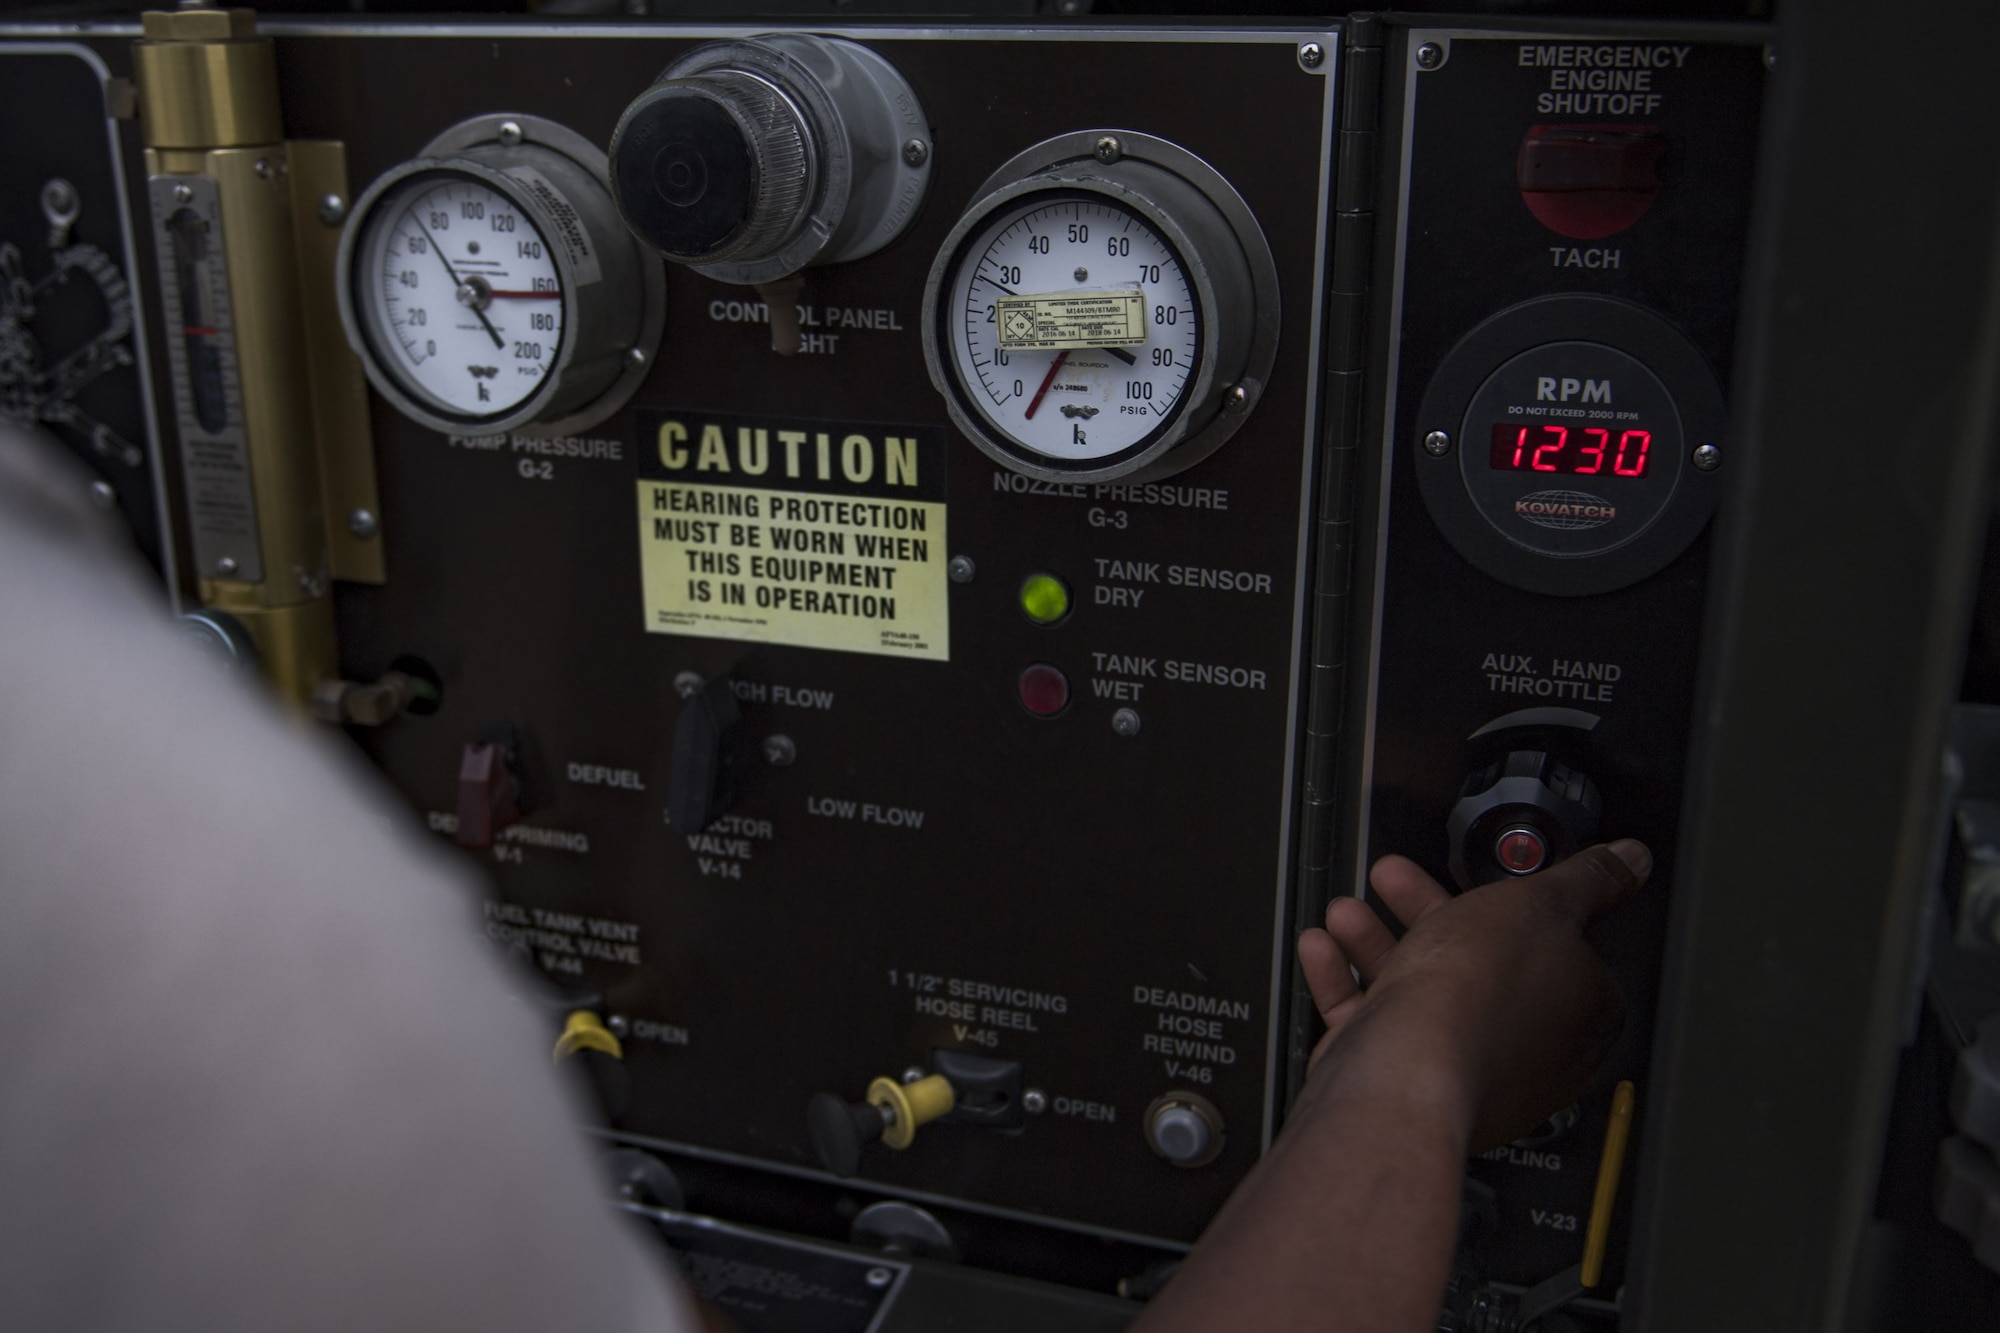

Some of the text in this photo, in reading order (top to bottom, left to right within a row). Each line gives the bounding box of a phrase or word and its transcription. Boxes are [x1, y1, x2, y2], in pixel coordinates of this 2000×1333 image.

[1518, 45, 1692, 68] EMERGENCY
[1550, 69, 1653, 92] ENGINE
[1536, 92, 1662, 115] SHUTOFF
[430, 212, 449, 230] 80
[461, 202, 485, 220] 100
[491, 214, 515, 233] 120
[1068, 225, 1088, 243] 50
[408, 237, 427, 254] 60
[518, 241, 541, 259] 140
[1028, 236, 1049, 255] 40
[1108, 237, 1129, 257] 60
[1549, 247, 1620, 269] TACH
[400, 272, 418, 288] 40
[1000, 266, 1020, 285] 30
[1139, 265, 1160, 284] 70
[408, 308, 427, 326] 20
[530, 313, 554, 331] 180
[826, 307, 904, 331] PANEL
[986, 306, 995, 323] 2
[1155, 306, 1176, 325] 80
[427, 340, 437, 357] 0
[514, 341, 541, 359] 200
[994, 348, 1008, 366] 10
[1152, 348, 1172, 367] 90
[1014, 380, 1023, 397] 0
[1126, 381, 1152, 400] 100
[1536, 376, 1612, 404] RPM
[1120, 406, 1147, 415] PSIG
[1508, 405, 1639, 421] DO NOT EXCEED 2000 RPM
[511, 433, 623, 460] PRESSURE
[657, 420, 919, 487] CAUTION
[1512, 425, 1652, 477] 1230
[518, 458, 554, 480] G-2
[992, 472, 1229, 510] NOZZLE PRESSURE
[653, 488, 926, 531] HEARING PROTECTION
[1088, 507, 1128, 529] G-3
[1514, 501, 1616, 519] KOVATCH
[654, 518, 928, 562] MUST BE WORN WHEN
[685, 550, 896, 590] THIS EQUIPMENT
[1094, 558, 1272, 594] TANK SENSOR
[688, 580, 711, 602] IS
[722, 583, 745, 605] IN
[756, 585, 896, 620] OPERATION
[1094, 585, 1145, 608] DRY
[1092, 652, 1267, 690] TANK SENSOR
[1481, 653, 1621, 682] AUX. HAND
[772, 685, 834, 710] FLOW
[1092, 678, 1144, 701] WET
[1486, 673, 1614, 703] THROTTLE
[567, 762, 646, 791] DEFUEL
[808, 796, 925, 829] LOW FLOW
[494, 844, 523, 864] V-1
[687, 835, 752, 859] VALVE
[698, 857, 742, 880] V-14
[532, 908, 585, 935] TANK
[587, 918, 640, 942] VENT
[578, 938, 641, 965] VALVE
[888, 970, 1068, 1014] 1 1/2" SERVICING
[1133, 985, 1250, 1020] DEADMAN
[915, 996, 1038, 1032] HOSE REEL
[1158, 1012, 1223, 1039] HOSE
[632, 1019, 689, 1045] OPEN
[952, 1024, 999, 1048] V-45
[1143, 1033, 1236, 1064] REWIND
[1164, 1059, 1213, 1084] V-46
[1053, 1097, 1115, 1123] OPEN
[1531, 1208, 1576, 1231] V-23
